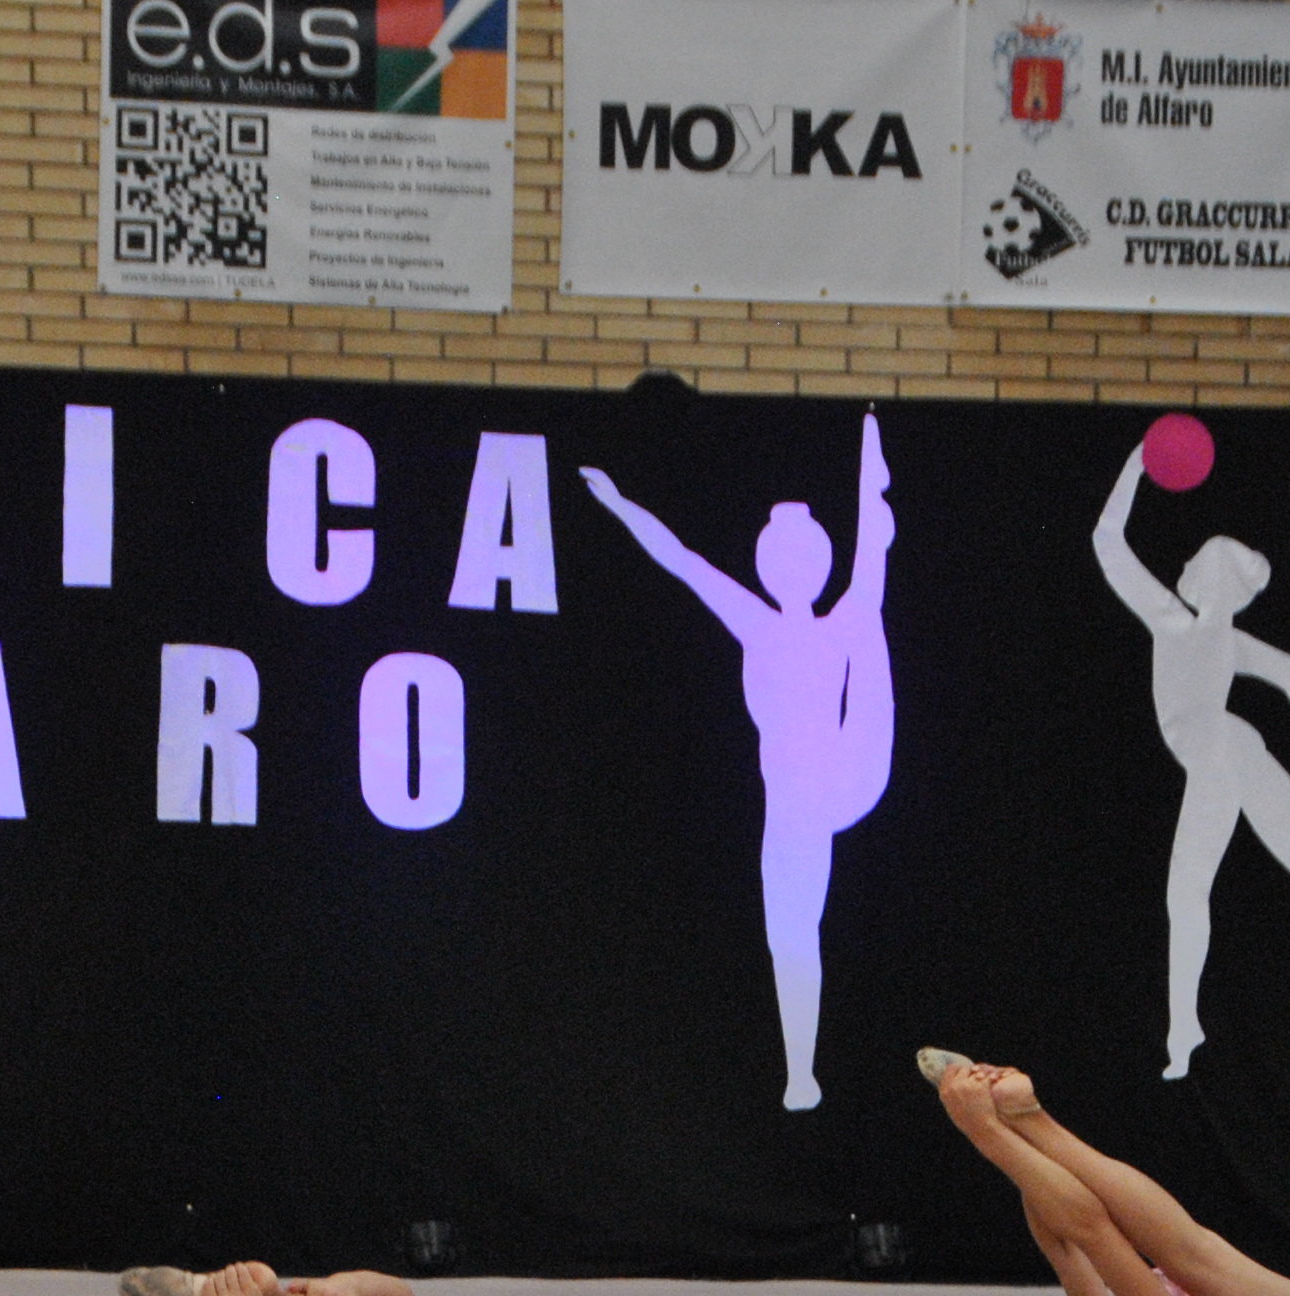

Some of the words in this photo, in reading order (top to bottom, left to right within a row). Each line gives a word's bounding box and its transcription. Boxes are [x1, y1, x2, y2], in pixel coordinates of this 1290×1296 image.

[1101, 49, 1148, 84] M.I.
[220, 77, 231, 93] y
[1101, 91, 1129, 125] de
[1137, 91, 1214, 128] Alfaro
[599, 101, 923, 179] MOKKA
[1106, 198, 1151, 227] C.D.
[1124, 236, 1230, 267] FUTBOL
